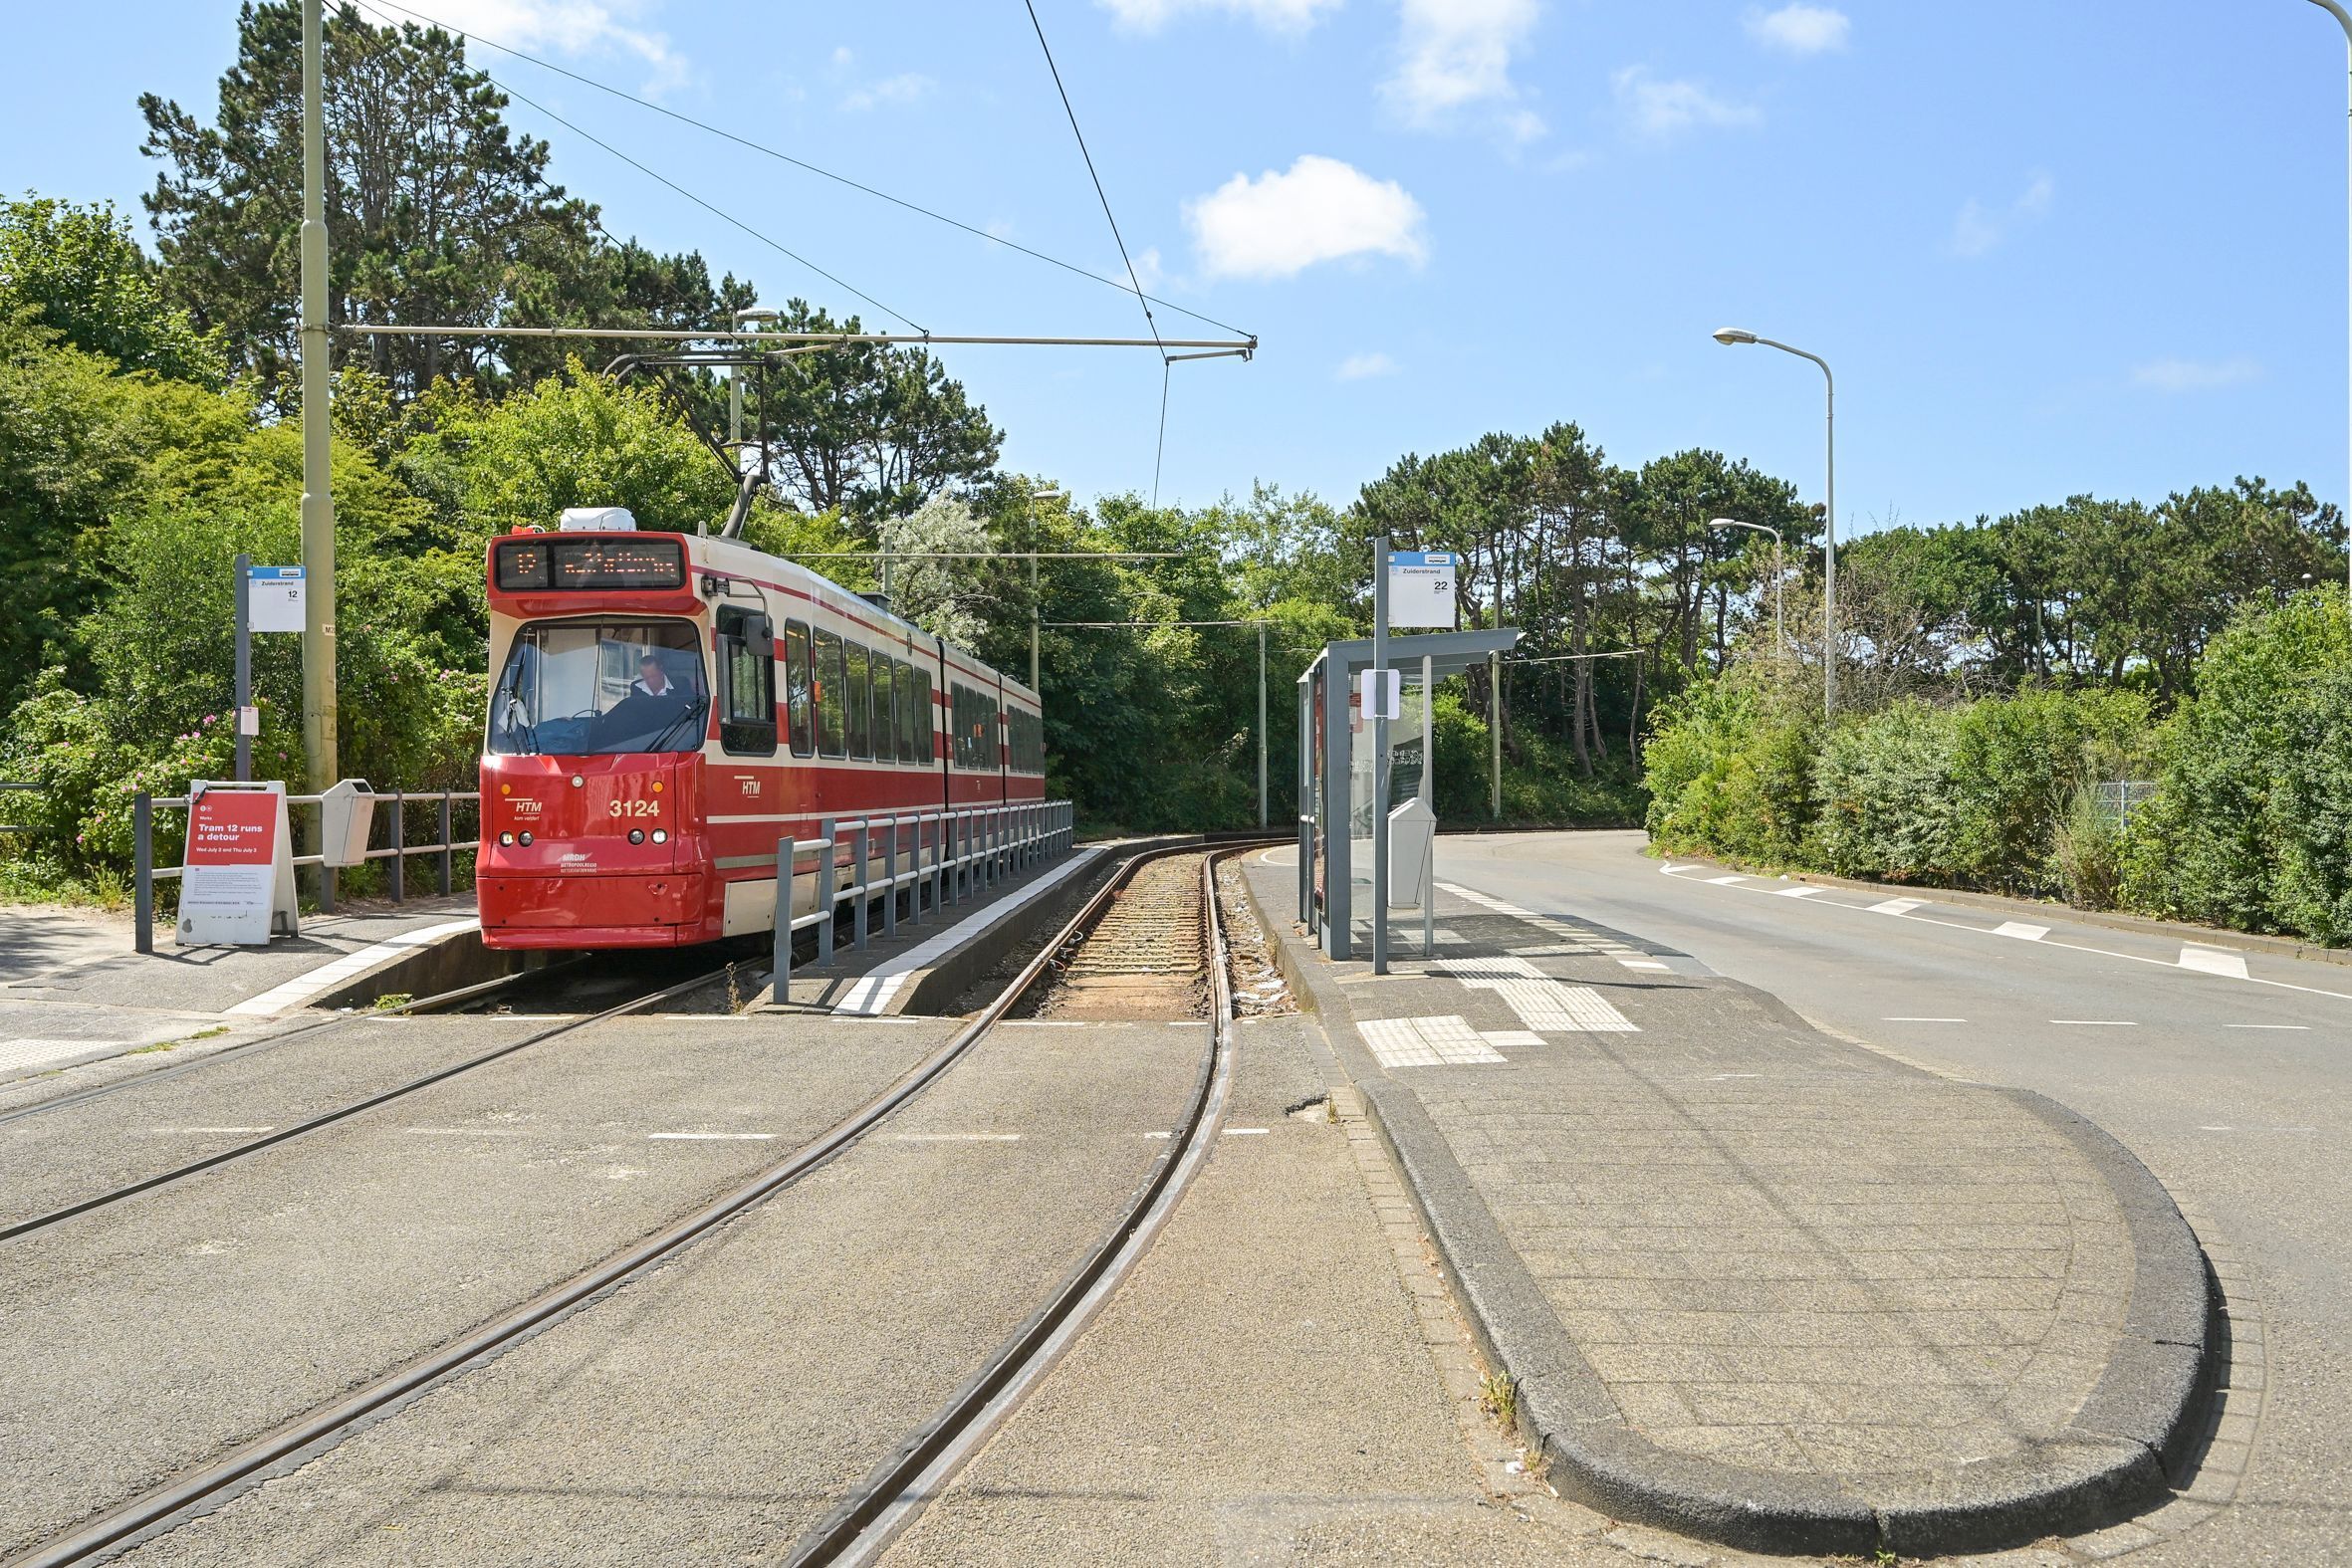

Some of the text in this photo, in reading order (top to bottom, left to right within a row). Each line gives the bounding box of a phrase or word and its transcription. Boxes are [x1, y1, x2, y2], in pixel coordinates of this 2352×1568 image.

[1434, 580, 1448, 590] 22
[288, 589, 298, 598] 12
[742, 781, 761, 794] HTM
[516, 801, 543, 812] HTM
[608, 799, 660, 817] 3124
